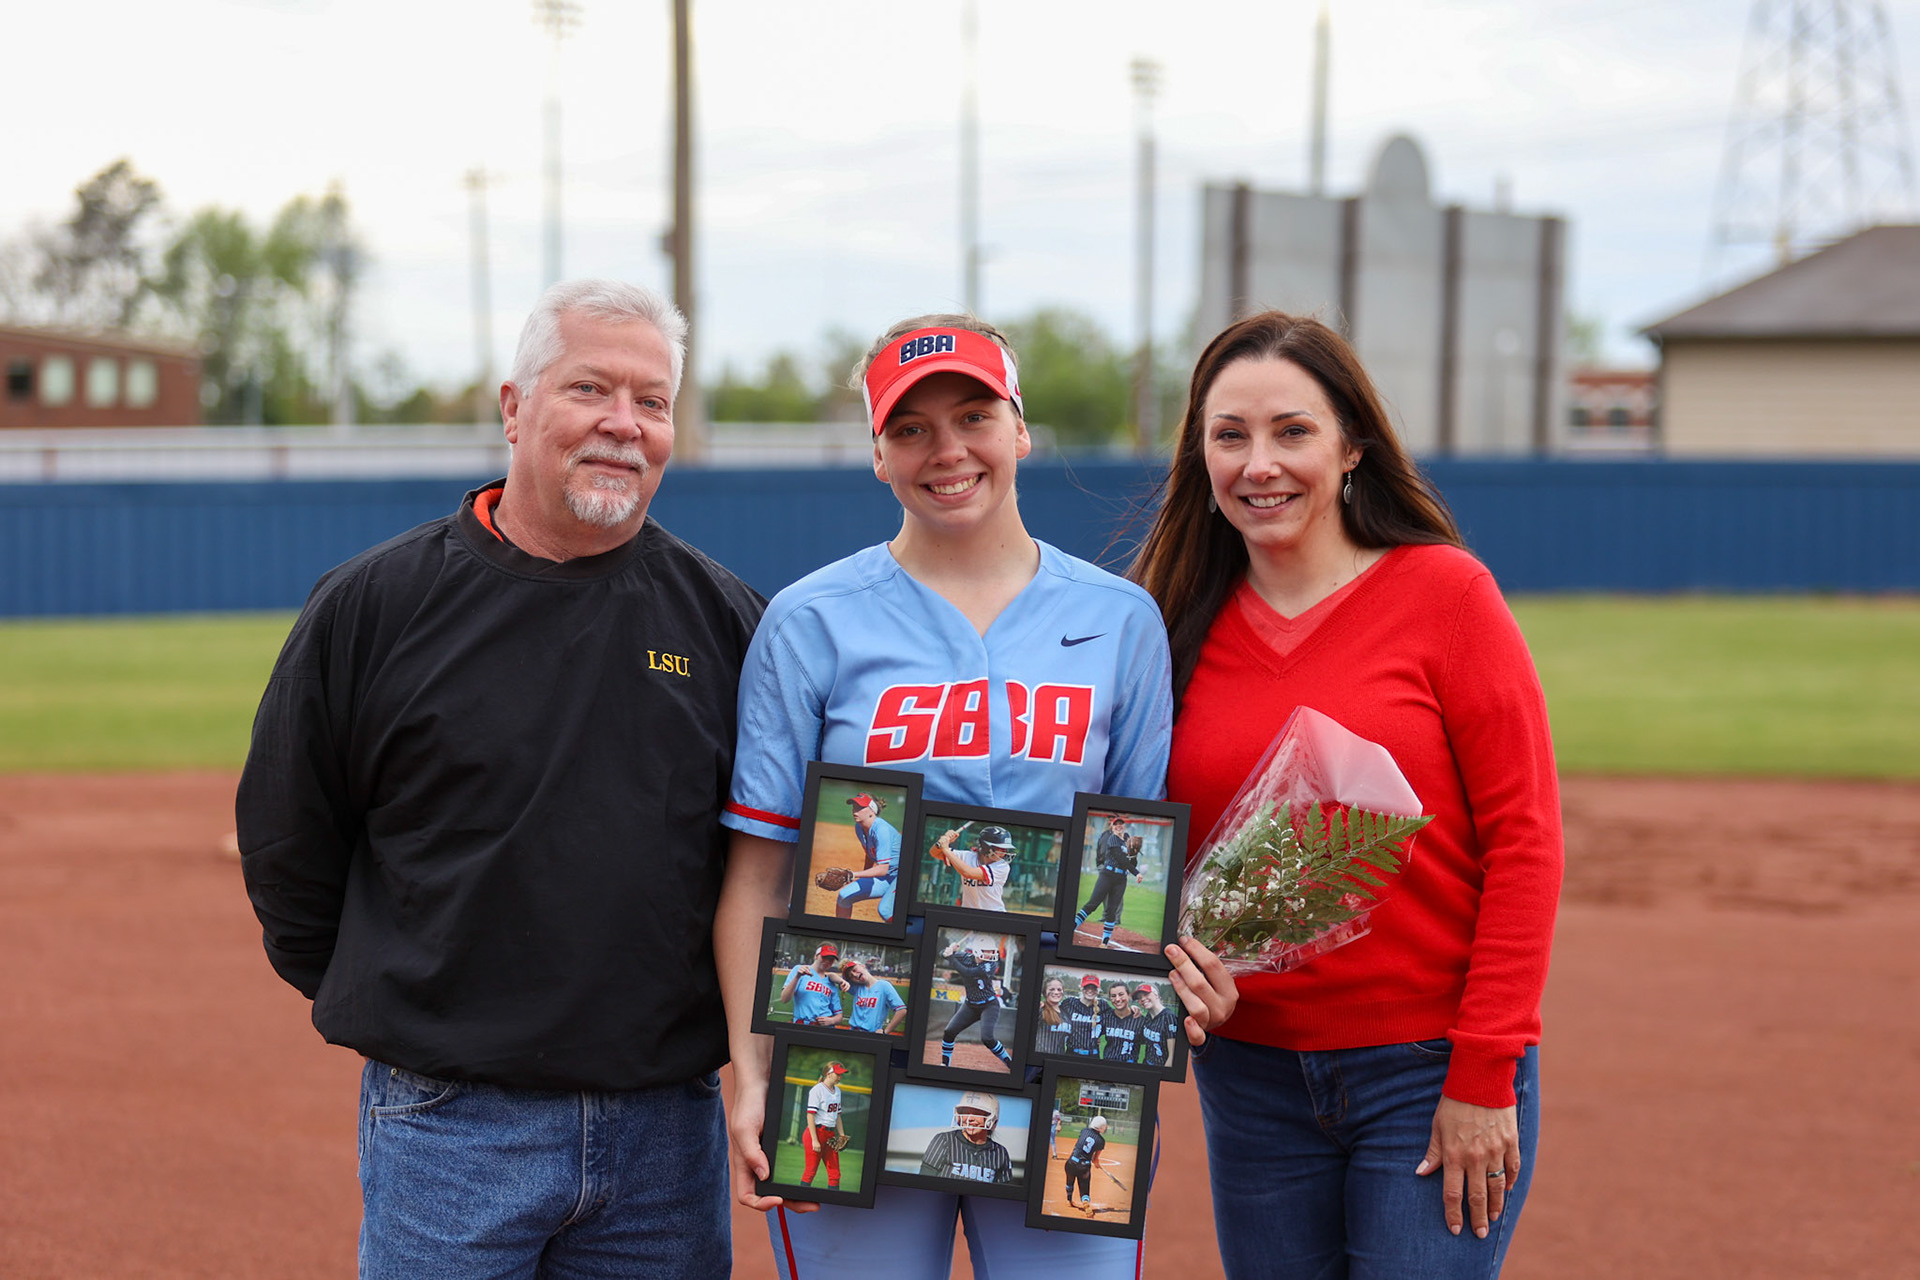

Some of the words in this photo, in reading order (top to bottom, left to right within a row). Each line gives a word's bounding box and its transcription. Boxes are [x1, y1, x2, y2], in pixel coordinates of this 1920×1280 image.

[899, 335, 956, 366] SBA
[647, 650, 689, 676] LSU
[864, 677, 1095, 766] SBA
[936, 990, 948, 1000] M
[1106, 1027, 1135, 1041] EAGLES
[1083, 1137, 1095, 1153] 3
[951, 1162, 996, 1183] EAGLES
